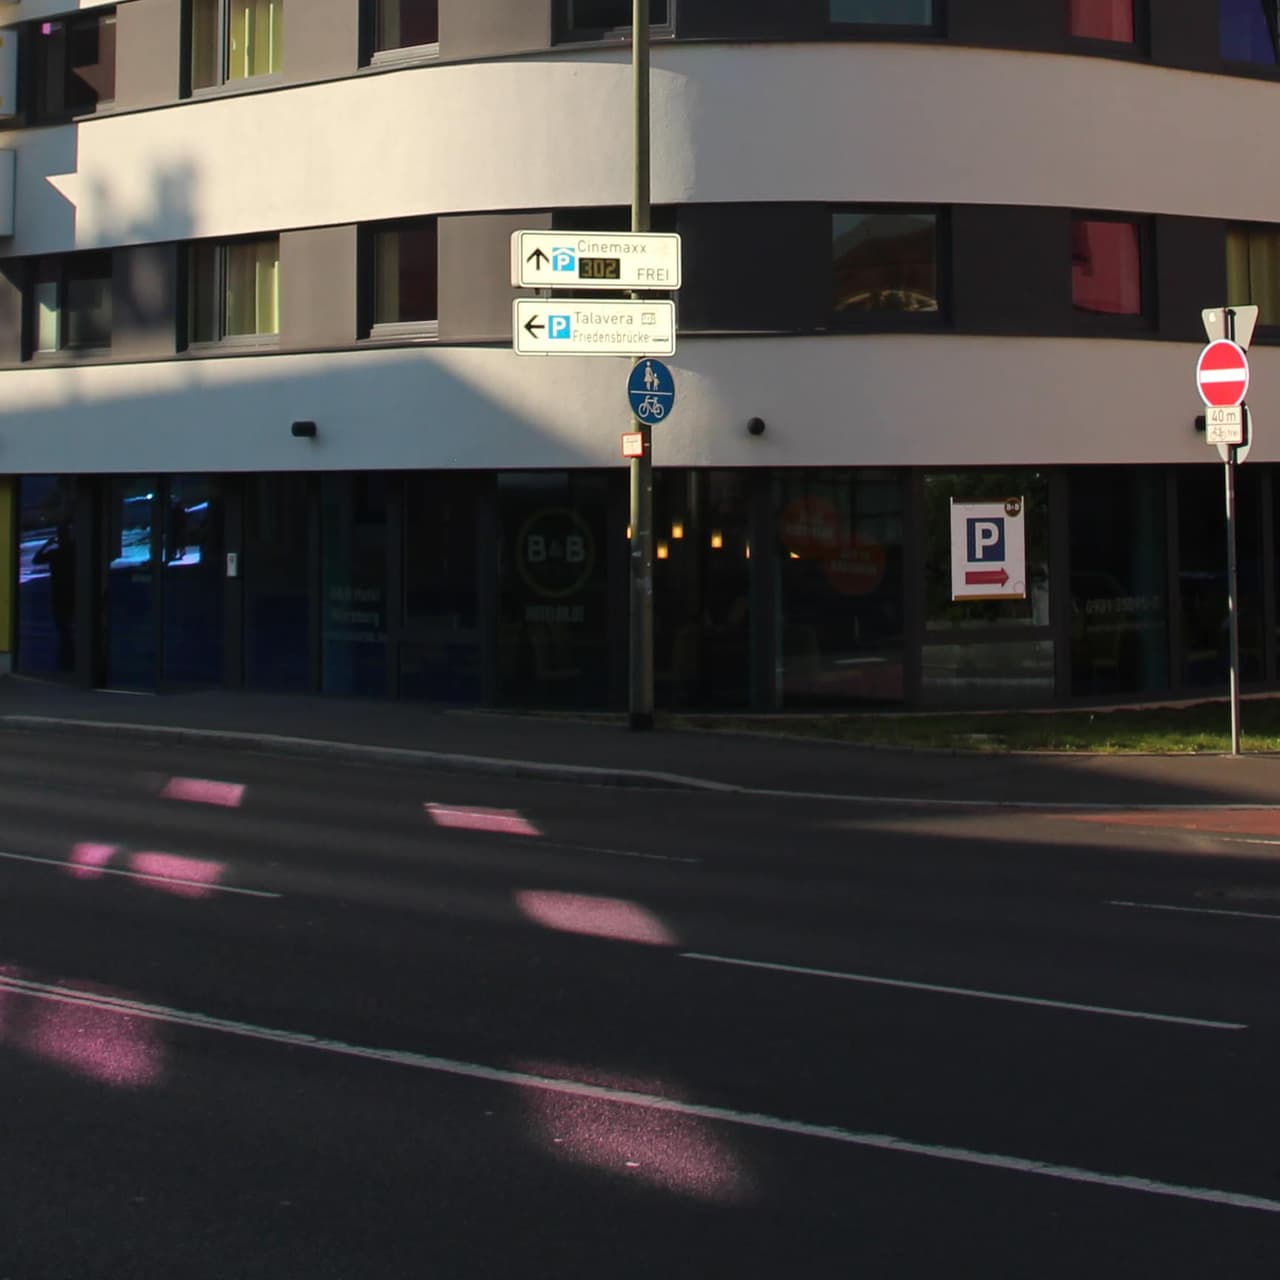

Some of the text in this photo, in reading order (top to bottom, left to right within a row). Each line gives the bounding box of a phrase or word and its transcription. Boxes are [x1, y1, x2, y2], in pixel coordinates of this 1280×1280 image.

[577, 239, 647, 254] Cinemaxx
[557, 255, 570, 270] P
[581, 260, 617, 278] 302
[637, 268, 669, 281] FREI
[575, 311, 633, 325] Talavera
[552, 317, 567, 337] P
[1212, 409, 1236, 422] 40 m
[974, 521, 1000, 560] P
